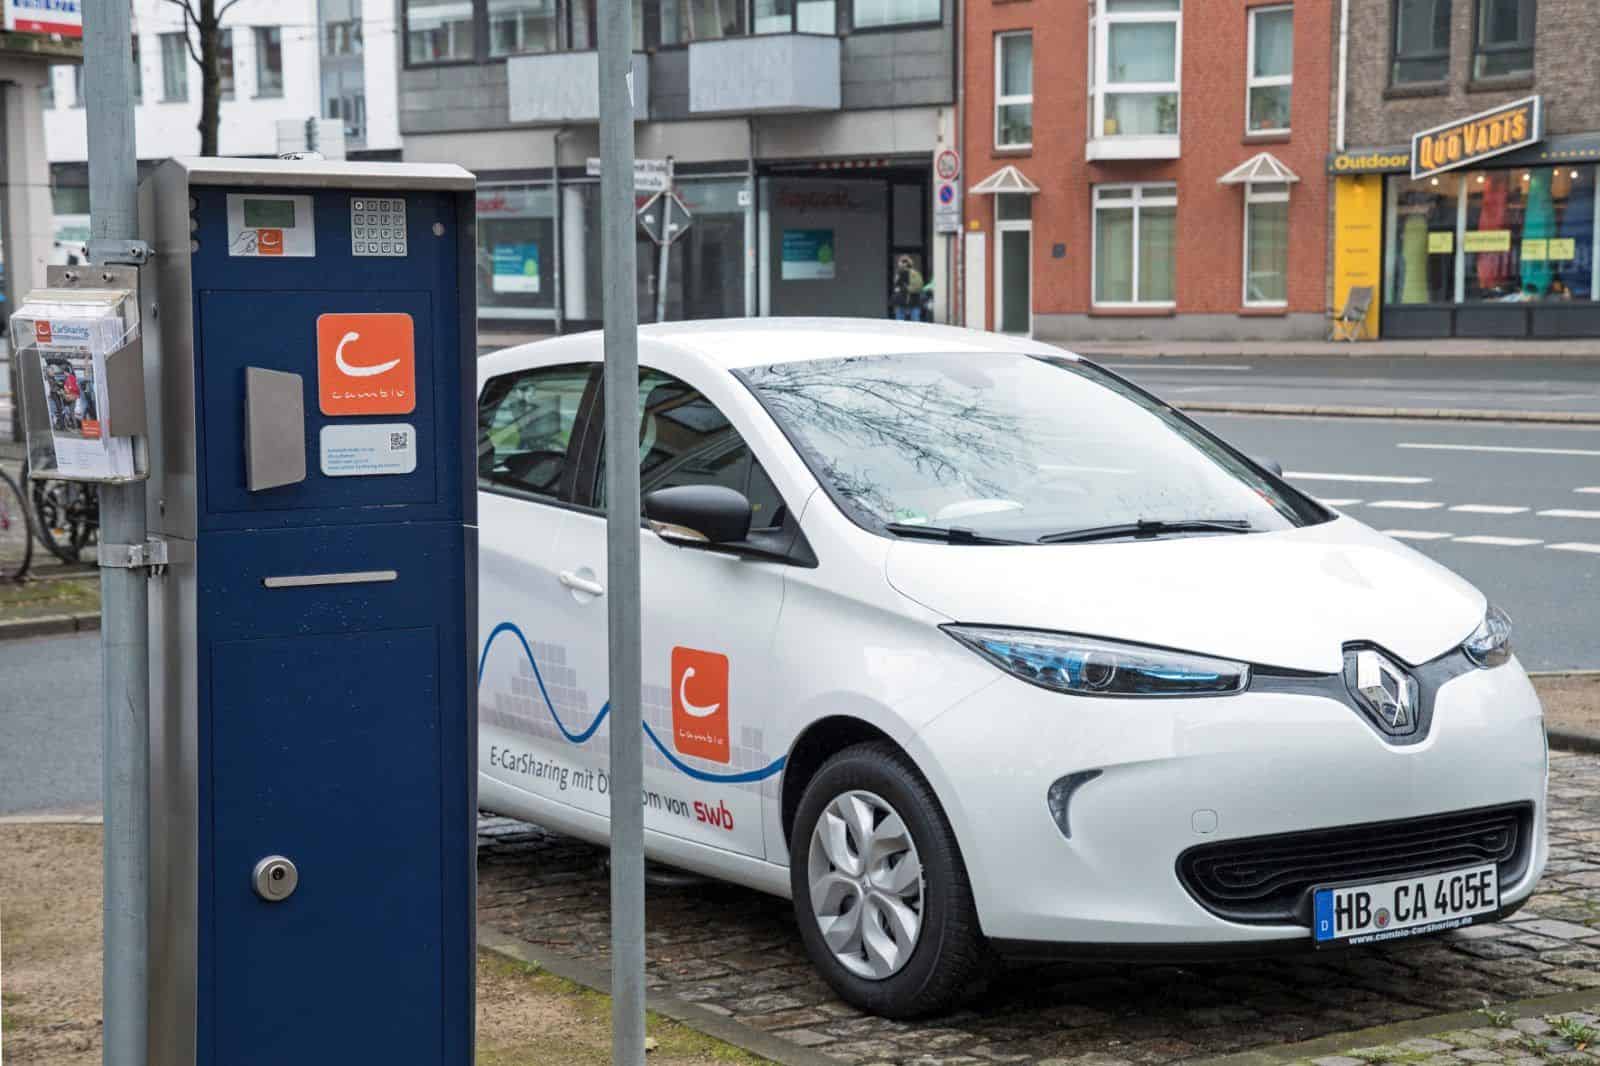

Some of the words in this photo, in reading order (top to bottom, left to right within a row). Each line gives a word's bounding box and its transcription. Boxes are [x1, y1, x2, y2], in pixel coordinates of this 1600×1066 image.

[1335, 153, 1409, 171] Outdoor
[331, 386, 405, 399] cambio
[679, 728, 723, 745] cambio
[490, 745, 569, 791] E-CarSharing
[572, 768, 594, 791] mit
[664, 796, 690, 818] von
[693, 799, 734, 830] swb
[1320, 920, 1329, 932] D
[1335, 892, 1372, 931] HB
[1394, 883, 1428, 922] CA
[1434, 870, 1494, 915] 405E
